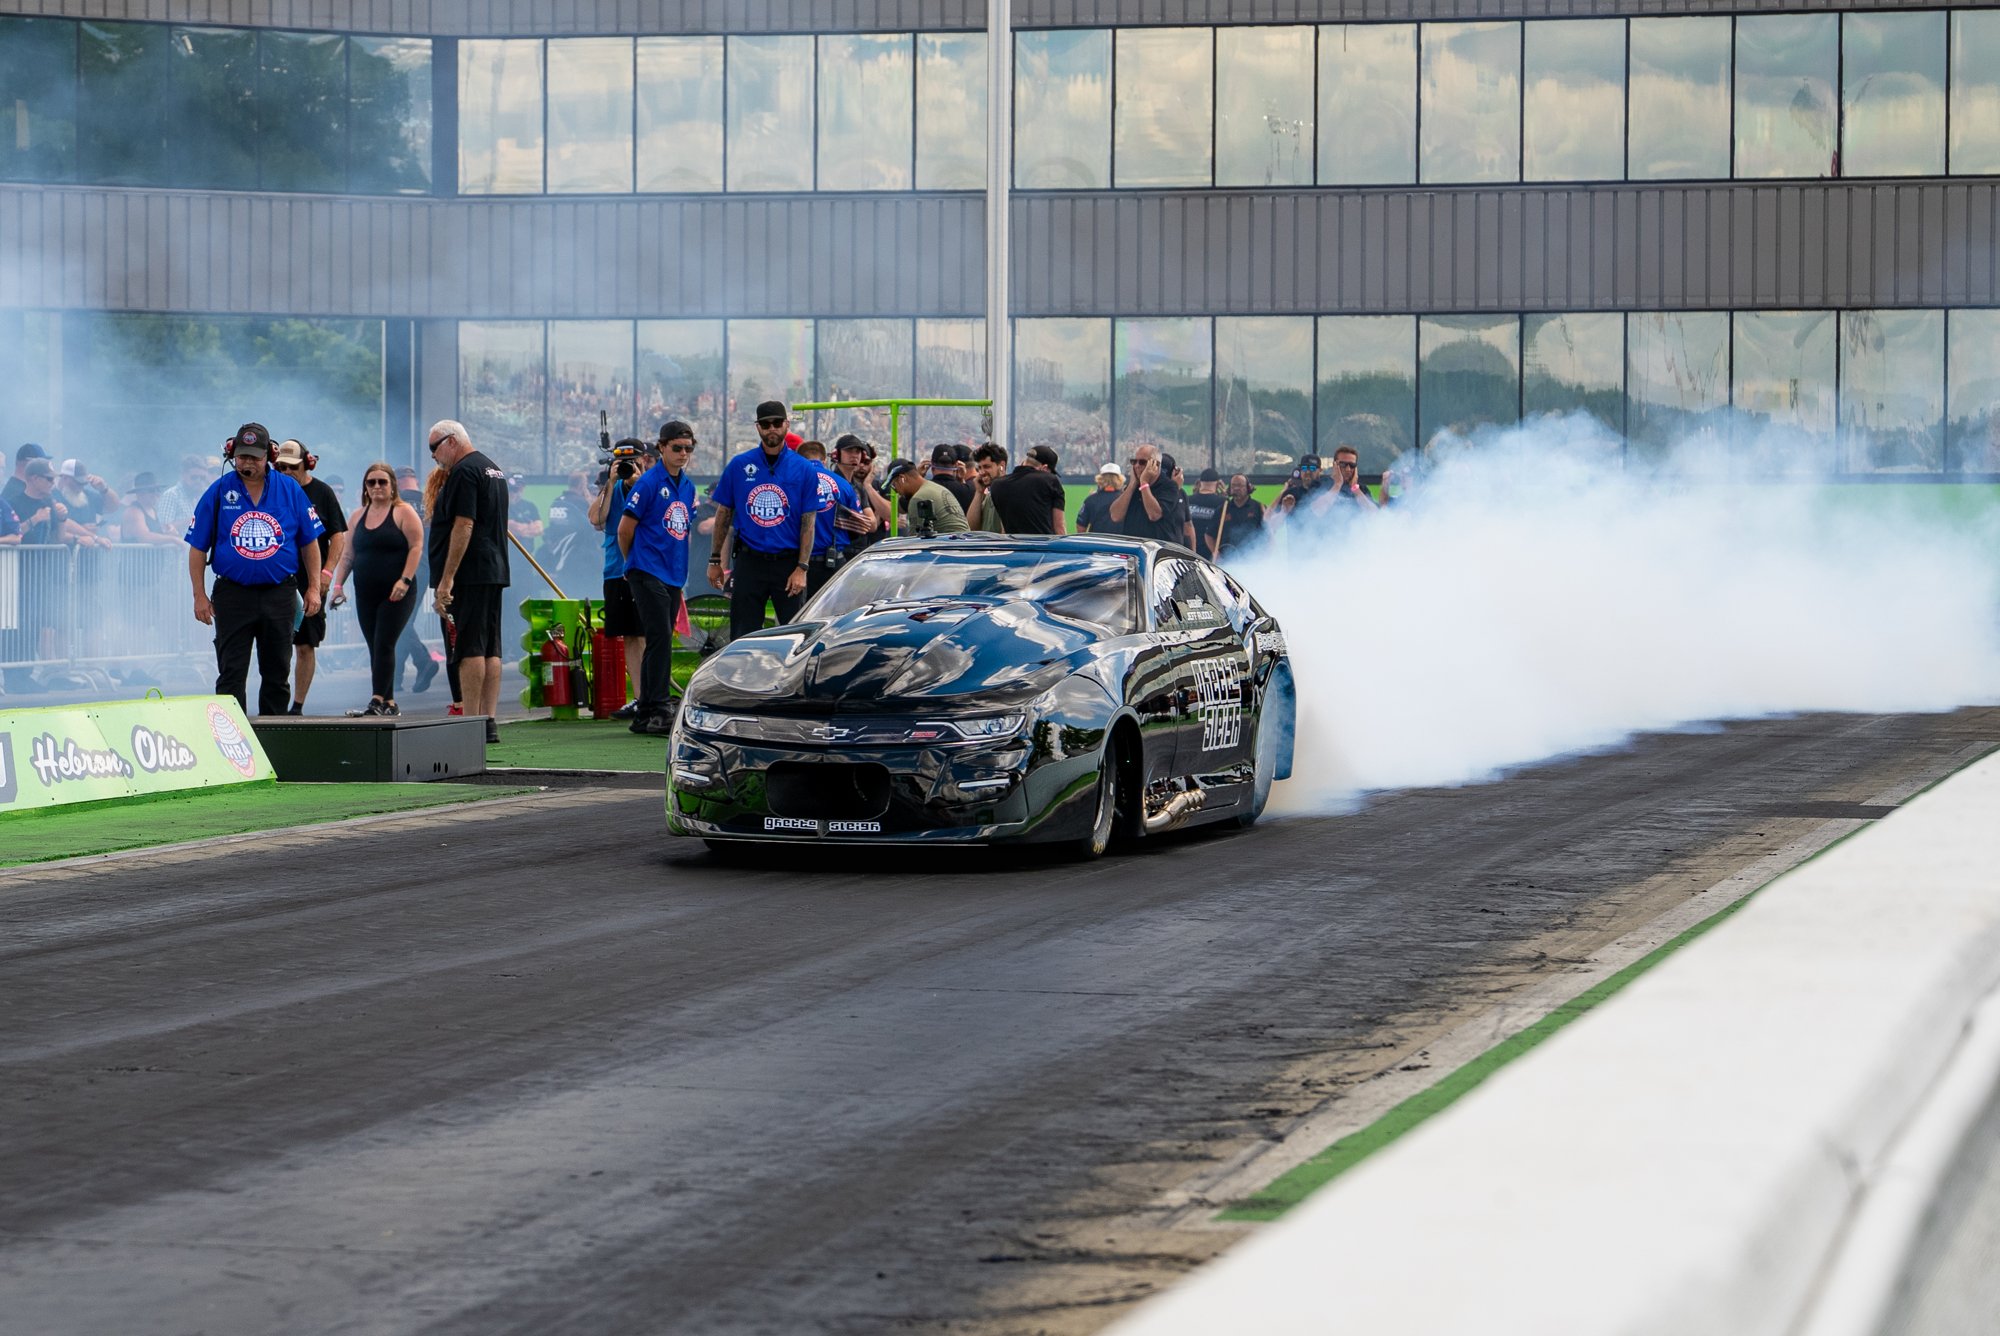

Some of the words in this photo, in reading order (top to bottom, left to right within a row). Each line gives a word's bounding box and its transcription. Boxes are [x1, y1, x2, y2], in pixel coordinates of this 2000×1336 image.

[750, 507, 785, 516] IHRA
[232, 512, 281, 534] INTERNATIONAL
[235, 536, 278, 547] IHRA
[34, 736, 132, 783] Hebron,
[134, 729, 195, 769] Ohio
[220, 742, 252, 761] IHRA
[764, 817, 818, 830] ghetto
